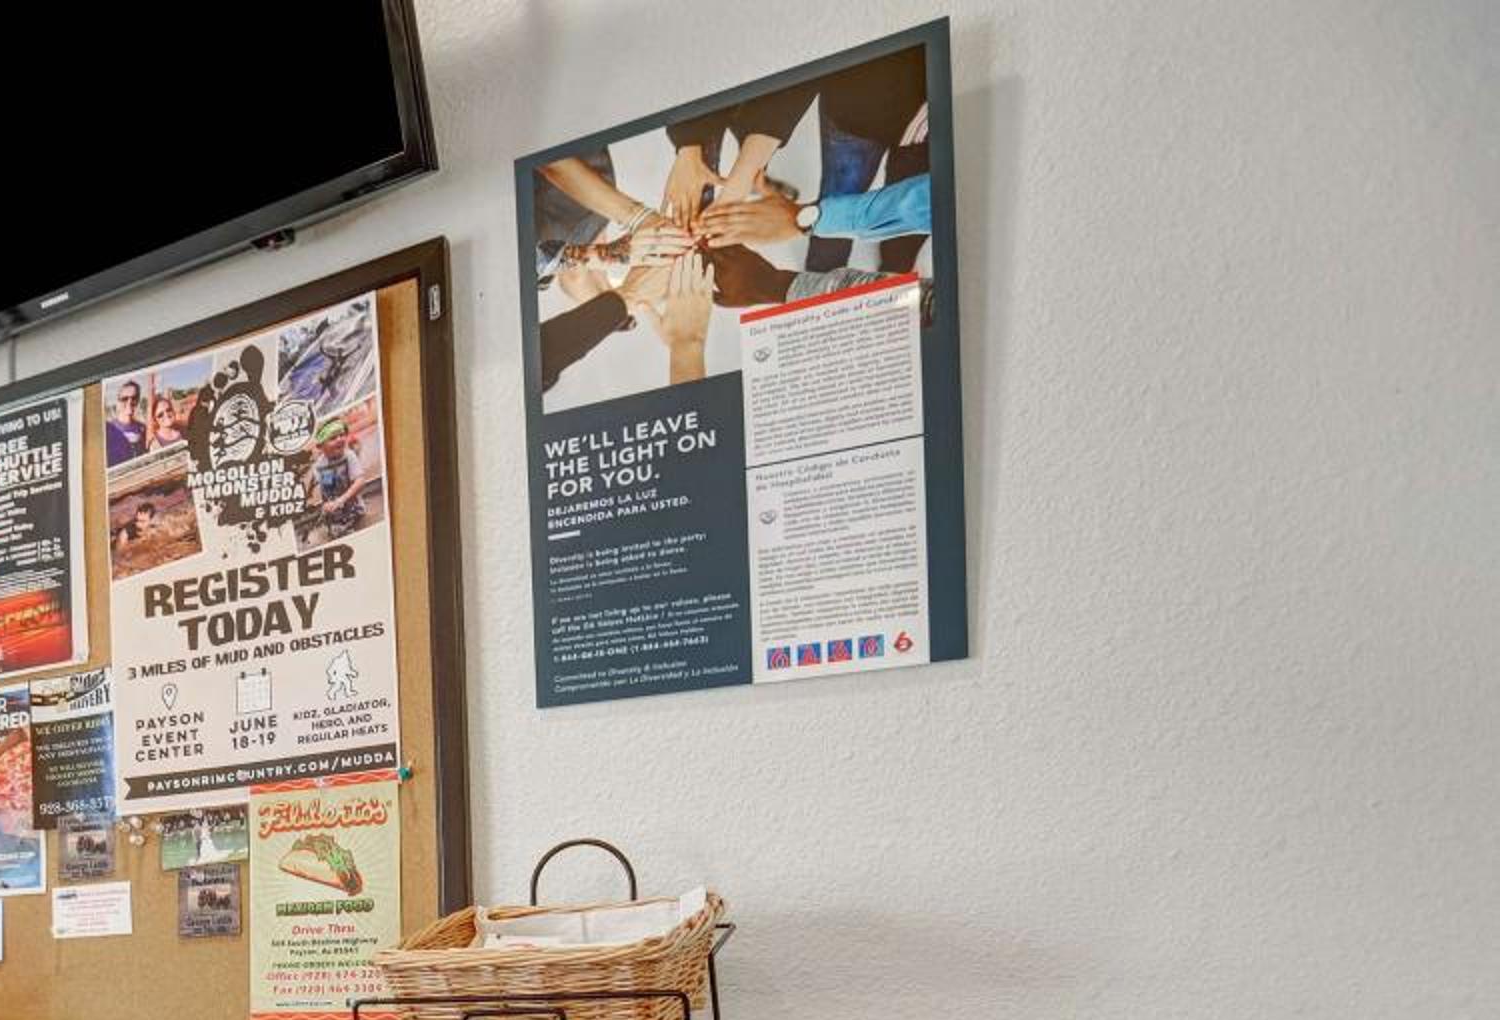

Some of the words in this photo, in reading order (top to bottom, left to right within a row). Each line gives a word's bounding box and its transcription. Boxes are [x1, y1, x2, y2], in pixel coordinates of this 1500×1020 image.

[26, 413, 41, 427] TO
[545, 428, 614, 459] WE'LL
[623, 412, 698, 443] LEAVE
[546, 456, 589, 479] THE
[599, 440, 668, 469] LIGHT
[677, 430, 716, 453] ON
[188, 458, 284, 488] MOGOLLON
[205, 472, 294, 499] MONSTER
[547, 476, 593, 500] FOR
[601, 464, 660, 490] YOU.
[241, 483, 305, 507] MUDDA
[547, 495, 615, 517] DEJAREMOS
[617, 492, 632, 505] LA
[634, 489, 658, 503] LUZ
[255, 507, 265, 519] &
[269, 501, 304, 516] KIDZ
[547, 510, 613, 529] ENCENDIDA
[617, 504, 647, 518] PARA
[651, 496, 690, 511] USTED.
[143, 543, 355, 618] REGISTER
[179, 592, 320, 650] TODAY
[127, 666, 137, 680] 3
[141, 659, 186, 679] MILES
[191, 655, 211, 669] OF
[215, 649, 249, 666] MUD
[253, 641, 285, 659] AND
[290, 621, 385, 652] OBSTACLES
[135, 711, 205, 732] PAYSON
[229, 715, 277, 734] JUNE
[347, 712, 372, 726] AND
[141, 728, 199, 747] EVENT
[232, 731, 276, 749] 18-19
[297, 730, 349, 745] REGULAR
[351, 723, 388, 738] HEATS
[135, 743, 204, 762] CENTER
